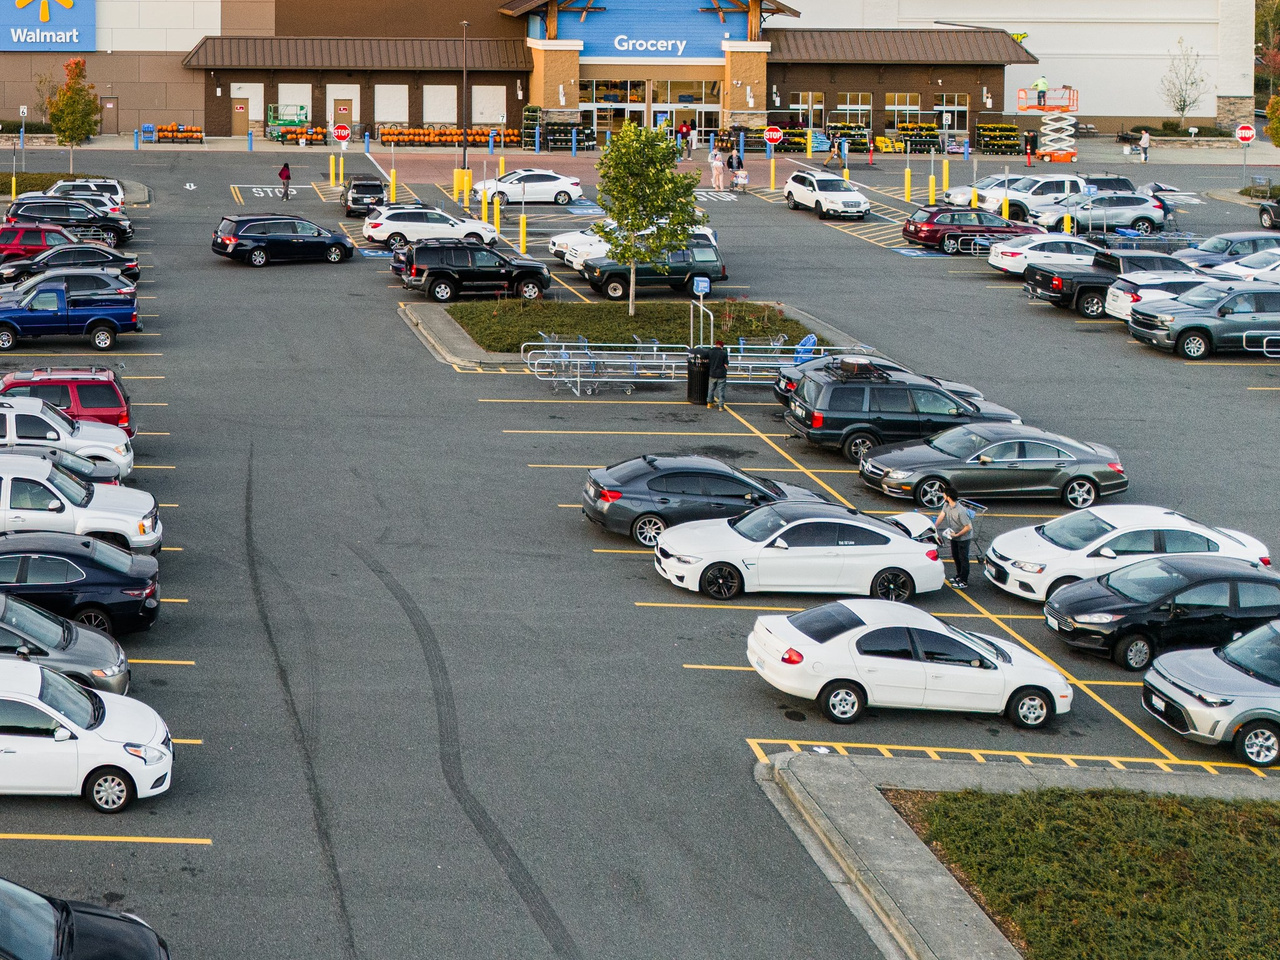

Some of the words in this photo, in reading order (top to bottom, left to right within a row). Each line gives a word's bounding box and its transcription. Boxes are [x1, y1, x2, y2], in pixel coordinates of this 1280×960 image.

[10, 28, 79, 43] Walmart
[614, 34, 687, 55] Grocery
[333, 129, 350, 137] STOP
[765, 131, 782, 139] STOP
[1237, 130, 1254, 138] STOP
